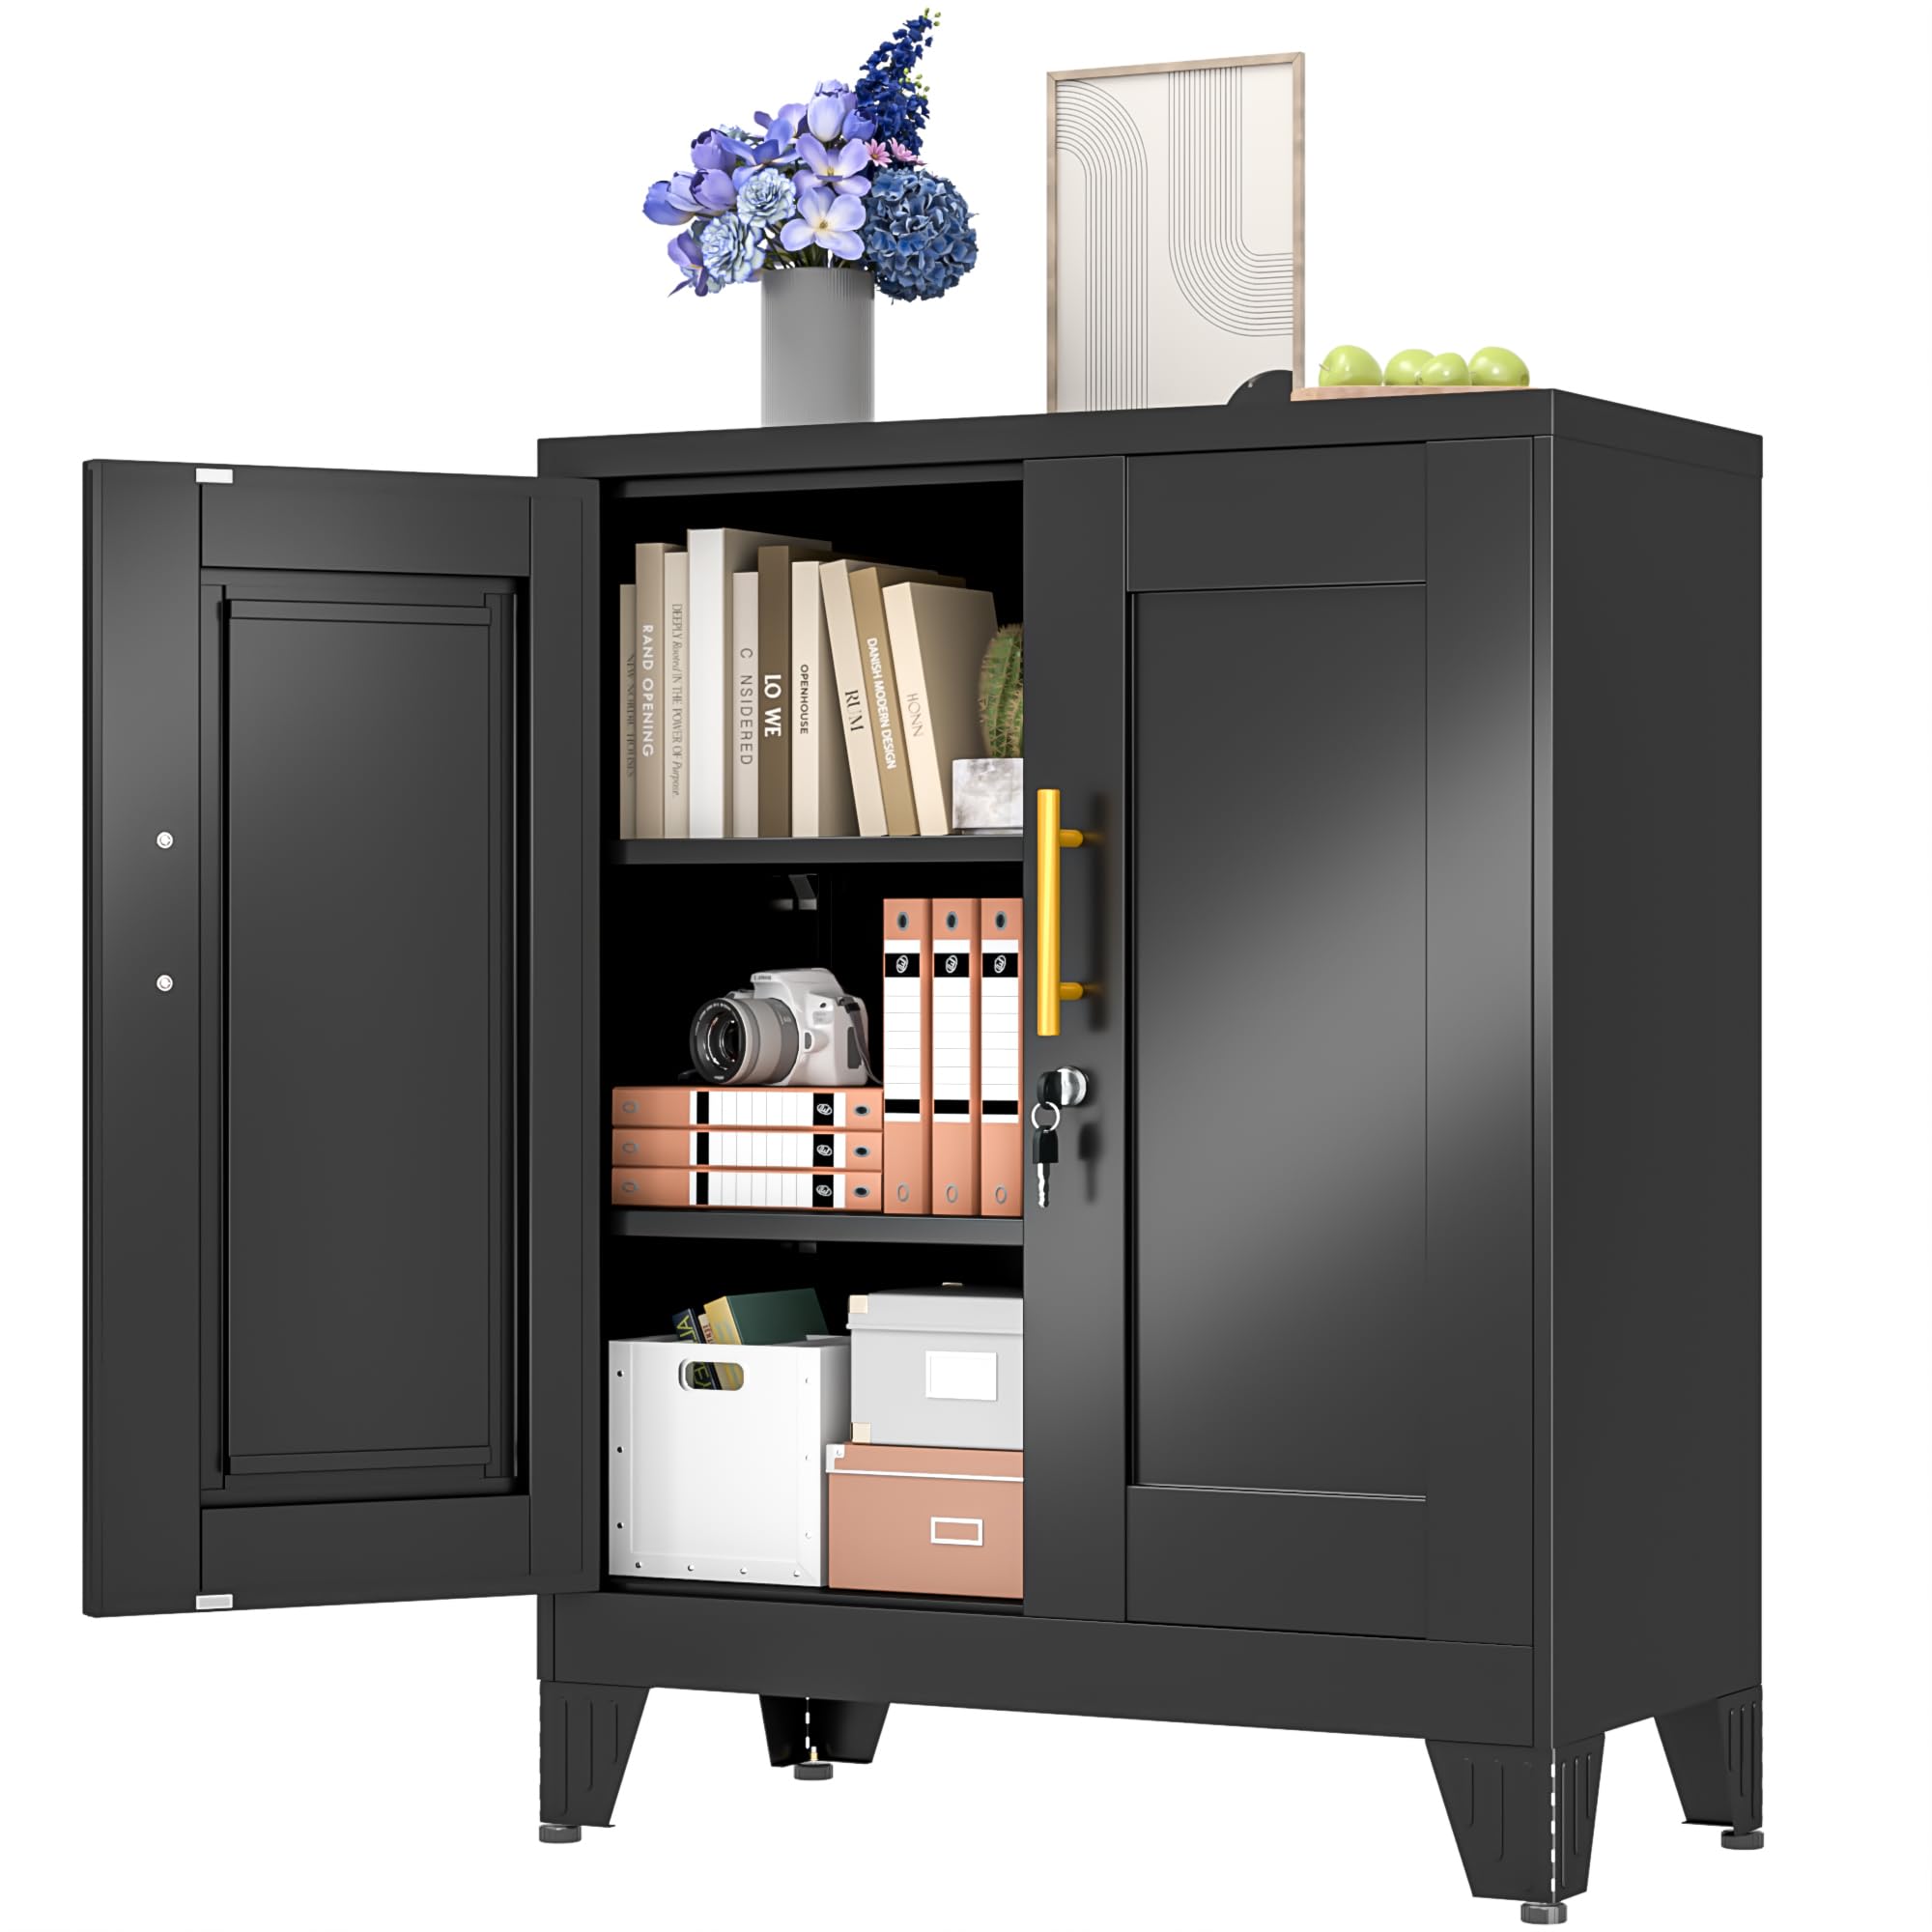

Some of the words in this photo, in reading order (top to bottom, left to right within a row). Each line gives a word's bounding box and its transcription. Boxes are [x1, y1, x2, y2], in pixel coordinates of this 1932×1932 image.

[642, 624, 654, 670] RAND
[867, 638, 883, 679] DANISH
[764, 674, 781, 698] LO
[800, 664, 810, 734] OPENHOUSE
[873, 680, 891, 728] MODERN
[642, 678, 654, 757] OPENING
[740, 675, 753, 765] NSIDERED
[764, 707, 781, 737] WE
[844, 690, 865, 731] RUM
[881, 728, 897, 770] DESIGN
